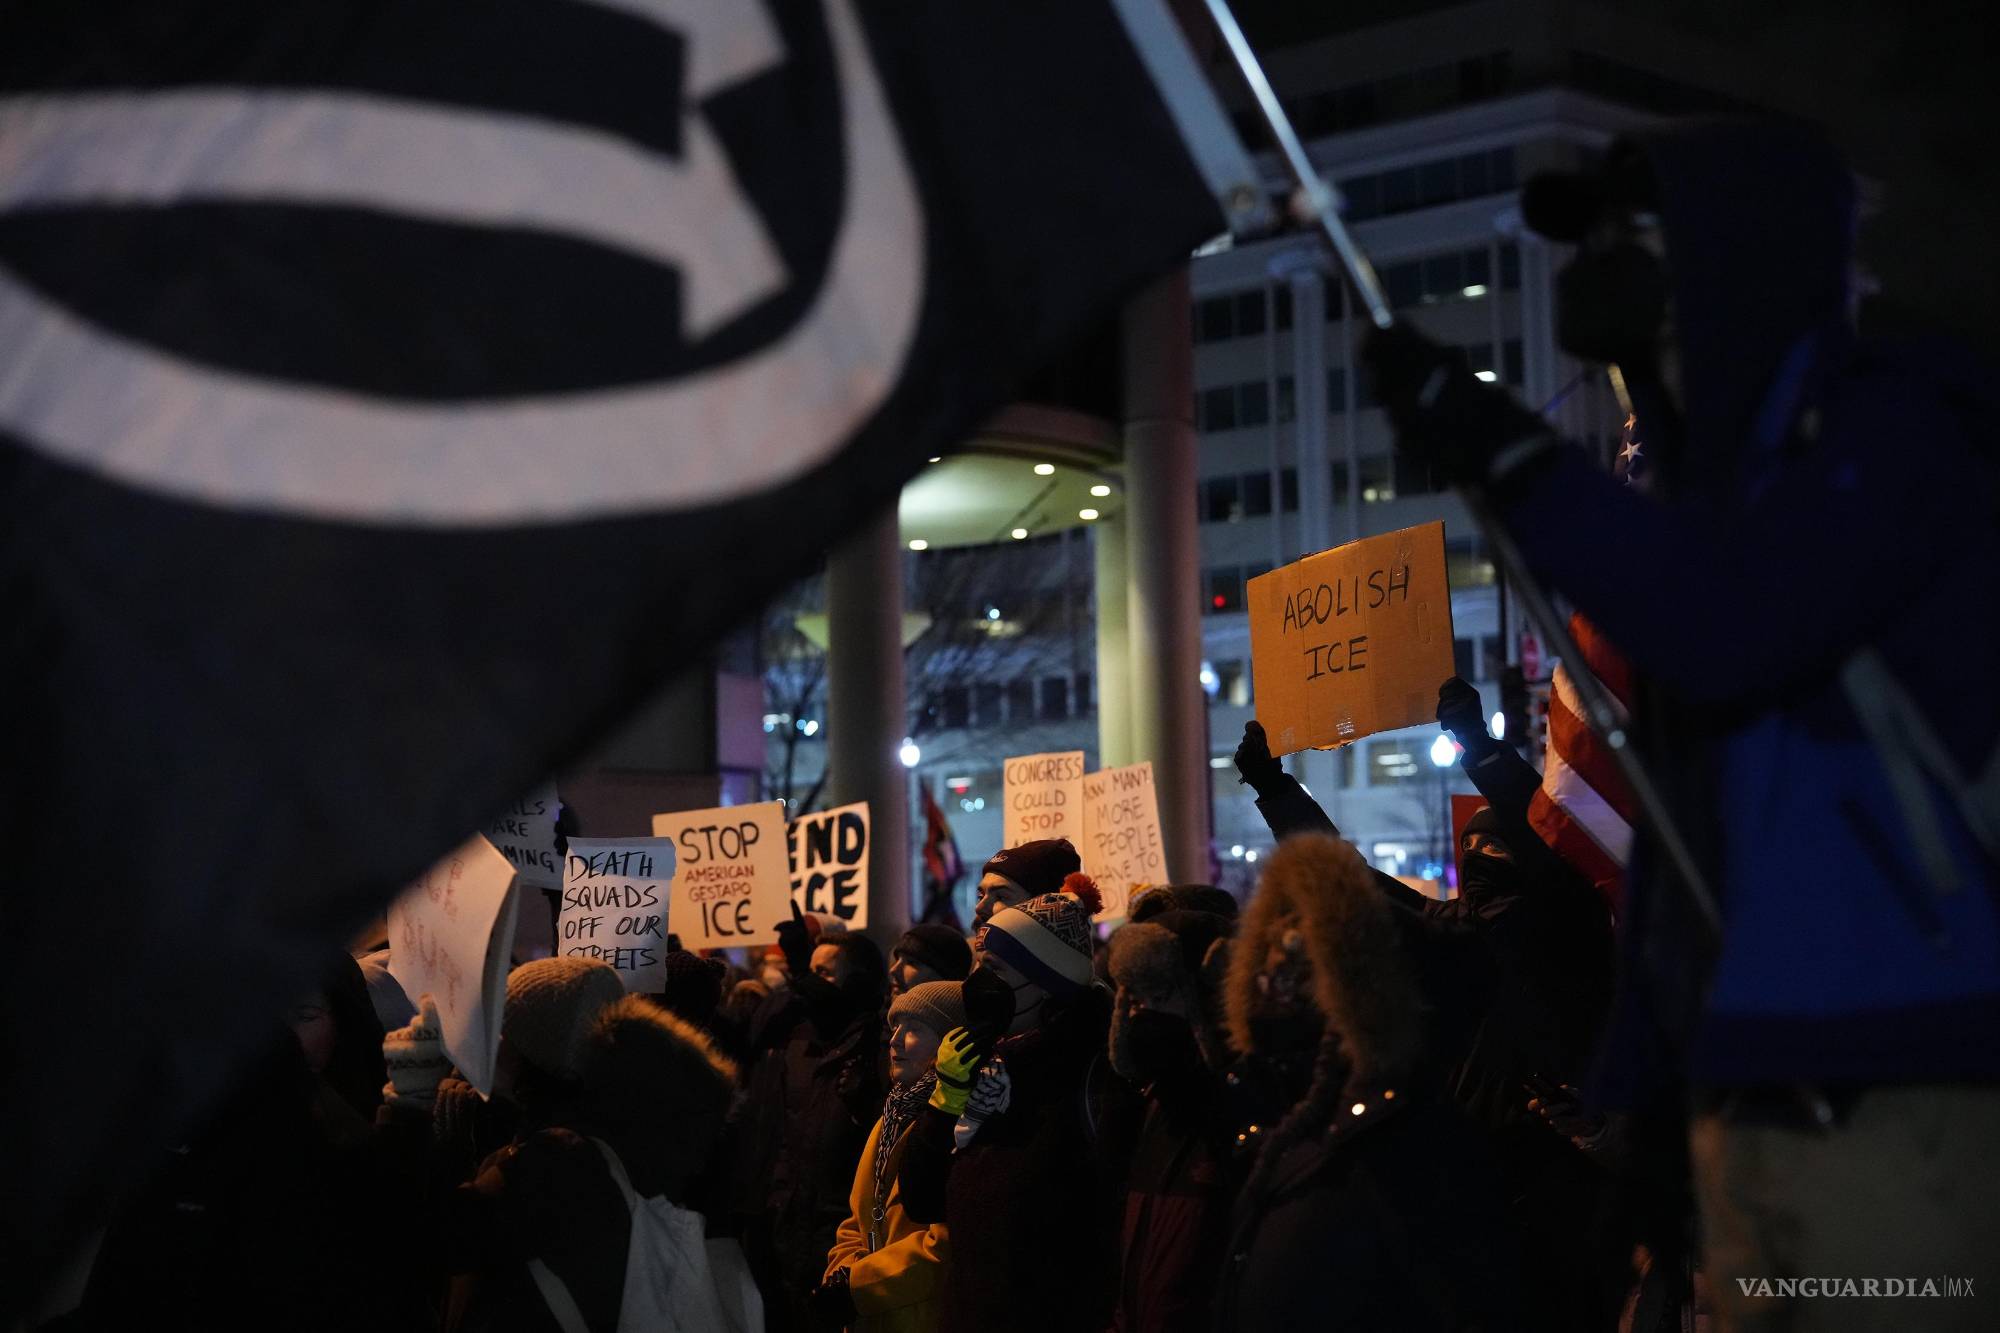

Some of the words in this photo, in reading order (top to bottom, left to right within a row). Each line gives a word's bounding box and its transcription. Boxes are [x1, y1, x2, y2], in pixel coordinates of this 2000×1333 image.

[1283, 565, 1409, 634] ABOLISH
[1304, 636, 1369, 680] ICE
[1006, 757, 1082, 786] CONGRESS
[1112, 767, 1148, 792] MANY
[1013, 789, 1067, 812] COULD
[1095, 795, 1145, 829] MORE
[492, 817, 529, 837] ARE
[1020, 812, 1064, 833] STOP
[680, 821, 759, 863] STOP
[1094, 823, 1158, 858] PEOPLE
[500, 845, 555, 873] MING
[568, 851, 653, 882] DEATH
[1089, 859, 1132, 883] HAVE
[1135, 852, 1159, 874] TO
[685, 864, 755, 884] AMERICAN
[563, 885, 659, 911] SQUADS
[689, 881, 752, 902] GESTAPO
[790, 869, 860, 921] CE
[565, 916, 603, 939] OFF
[615, 914, 664, 939] OUR
[702, 899, 755, 938] ICE
